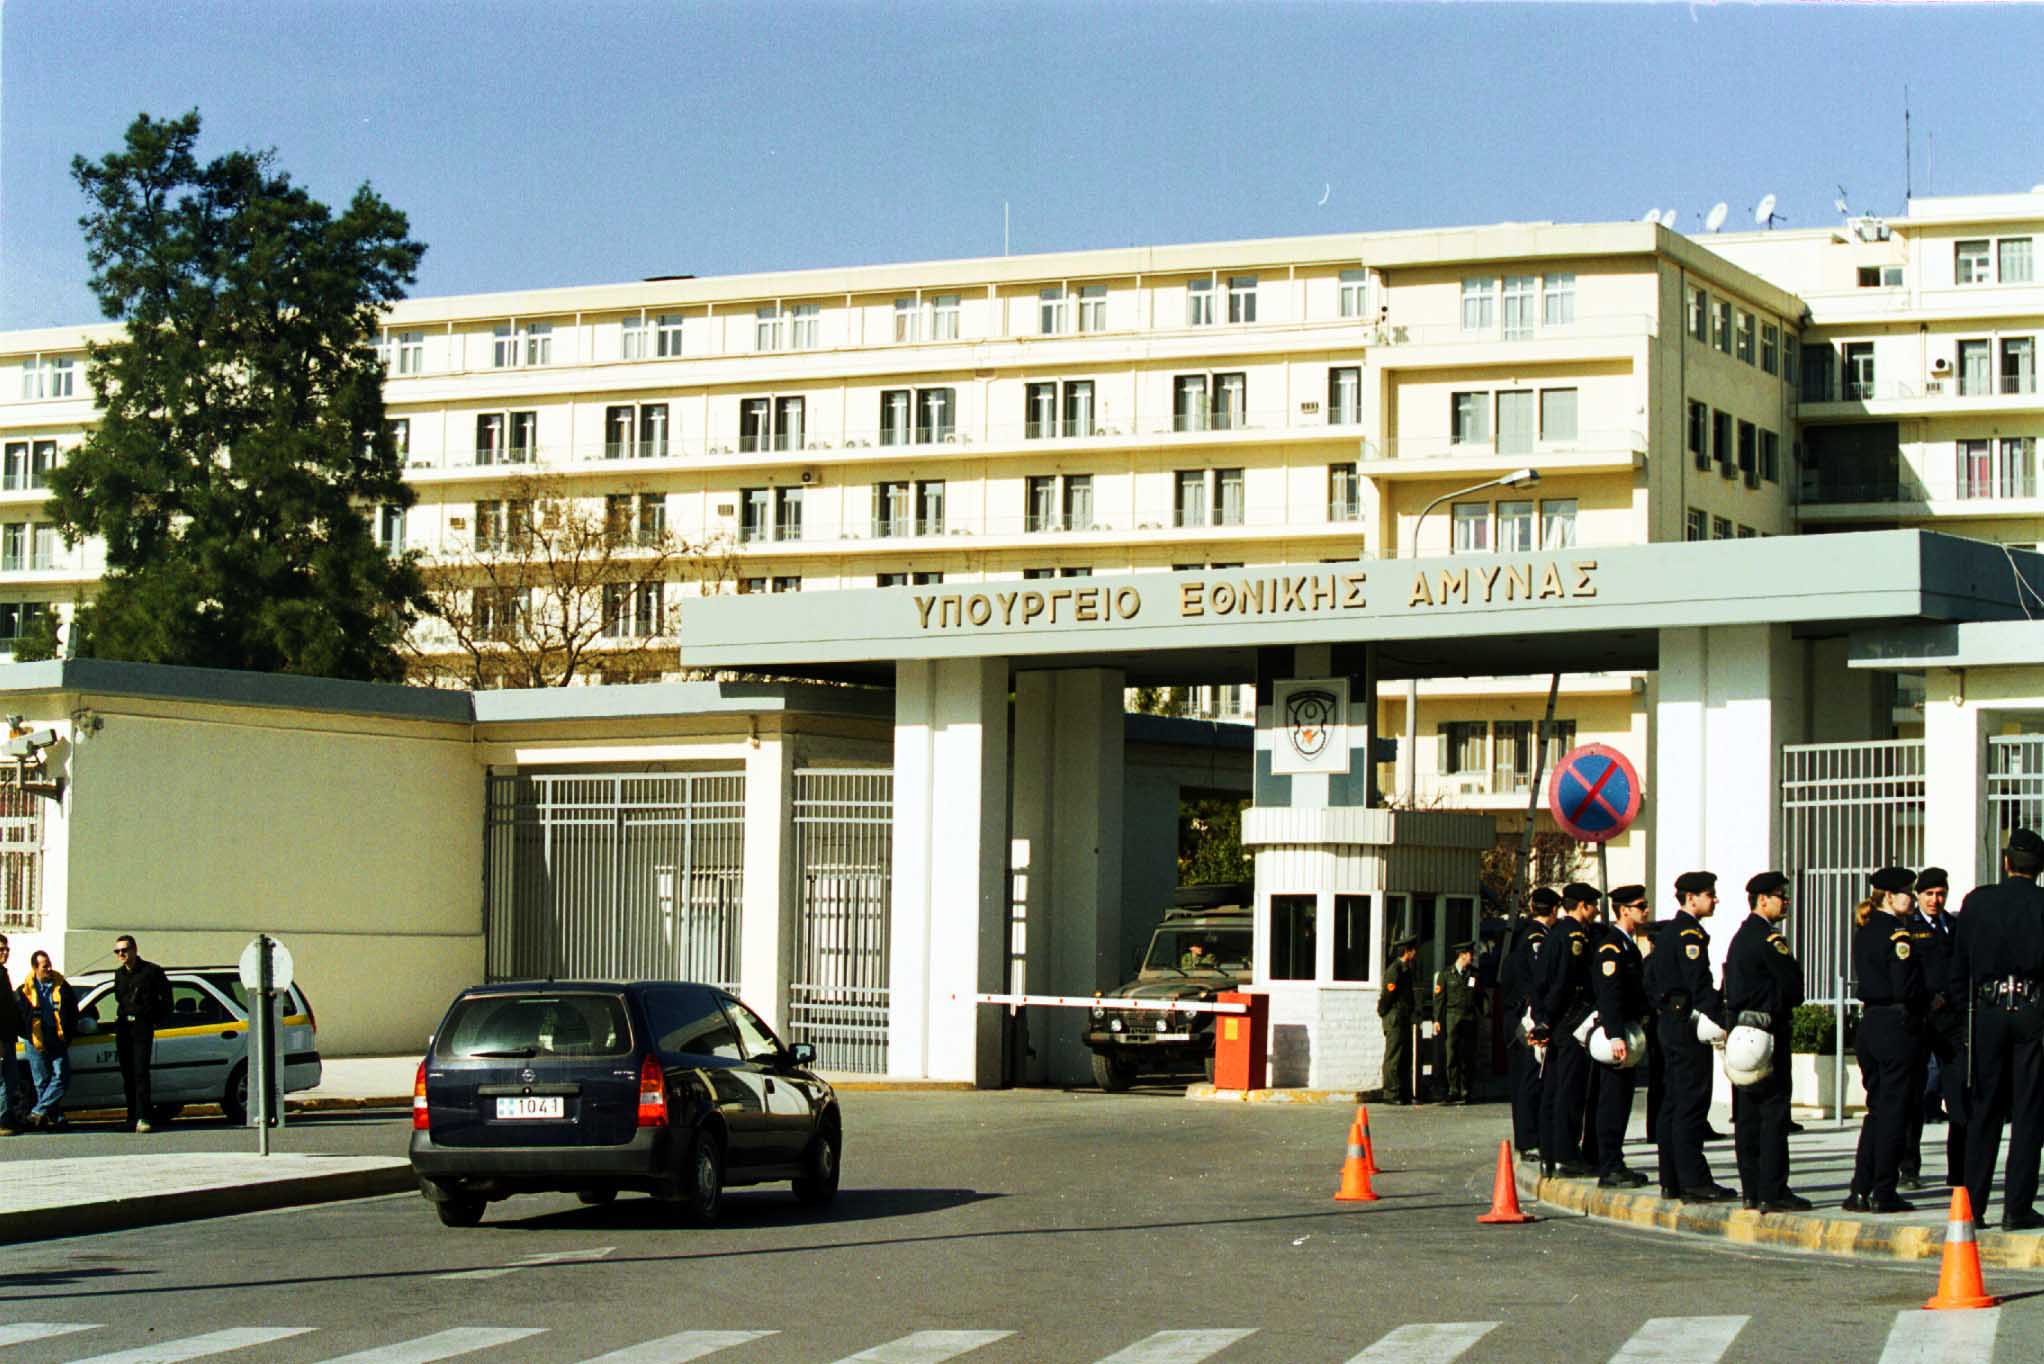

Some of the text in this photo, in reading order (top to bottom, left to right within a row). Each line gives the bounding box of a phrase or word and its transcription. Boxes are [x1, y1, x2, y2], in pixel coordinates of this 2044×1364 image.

[913, 559, 1598, 629] ΥΠΟΥΡΓΕΙΟ ΕΘΝΙΚΗΣ ΑΜΥΝΑΣ
[519, 1097, 558, 1113] 1041
